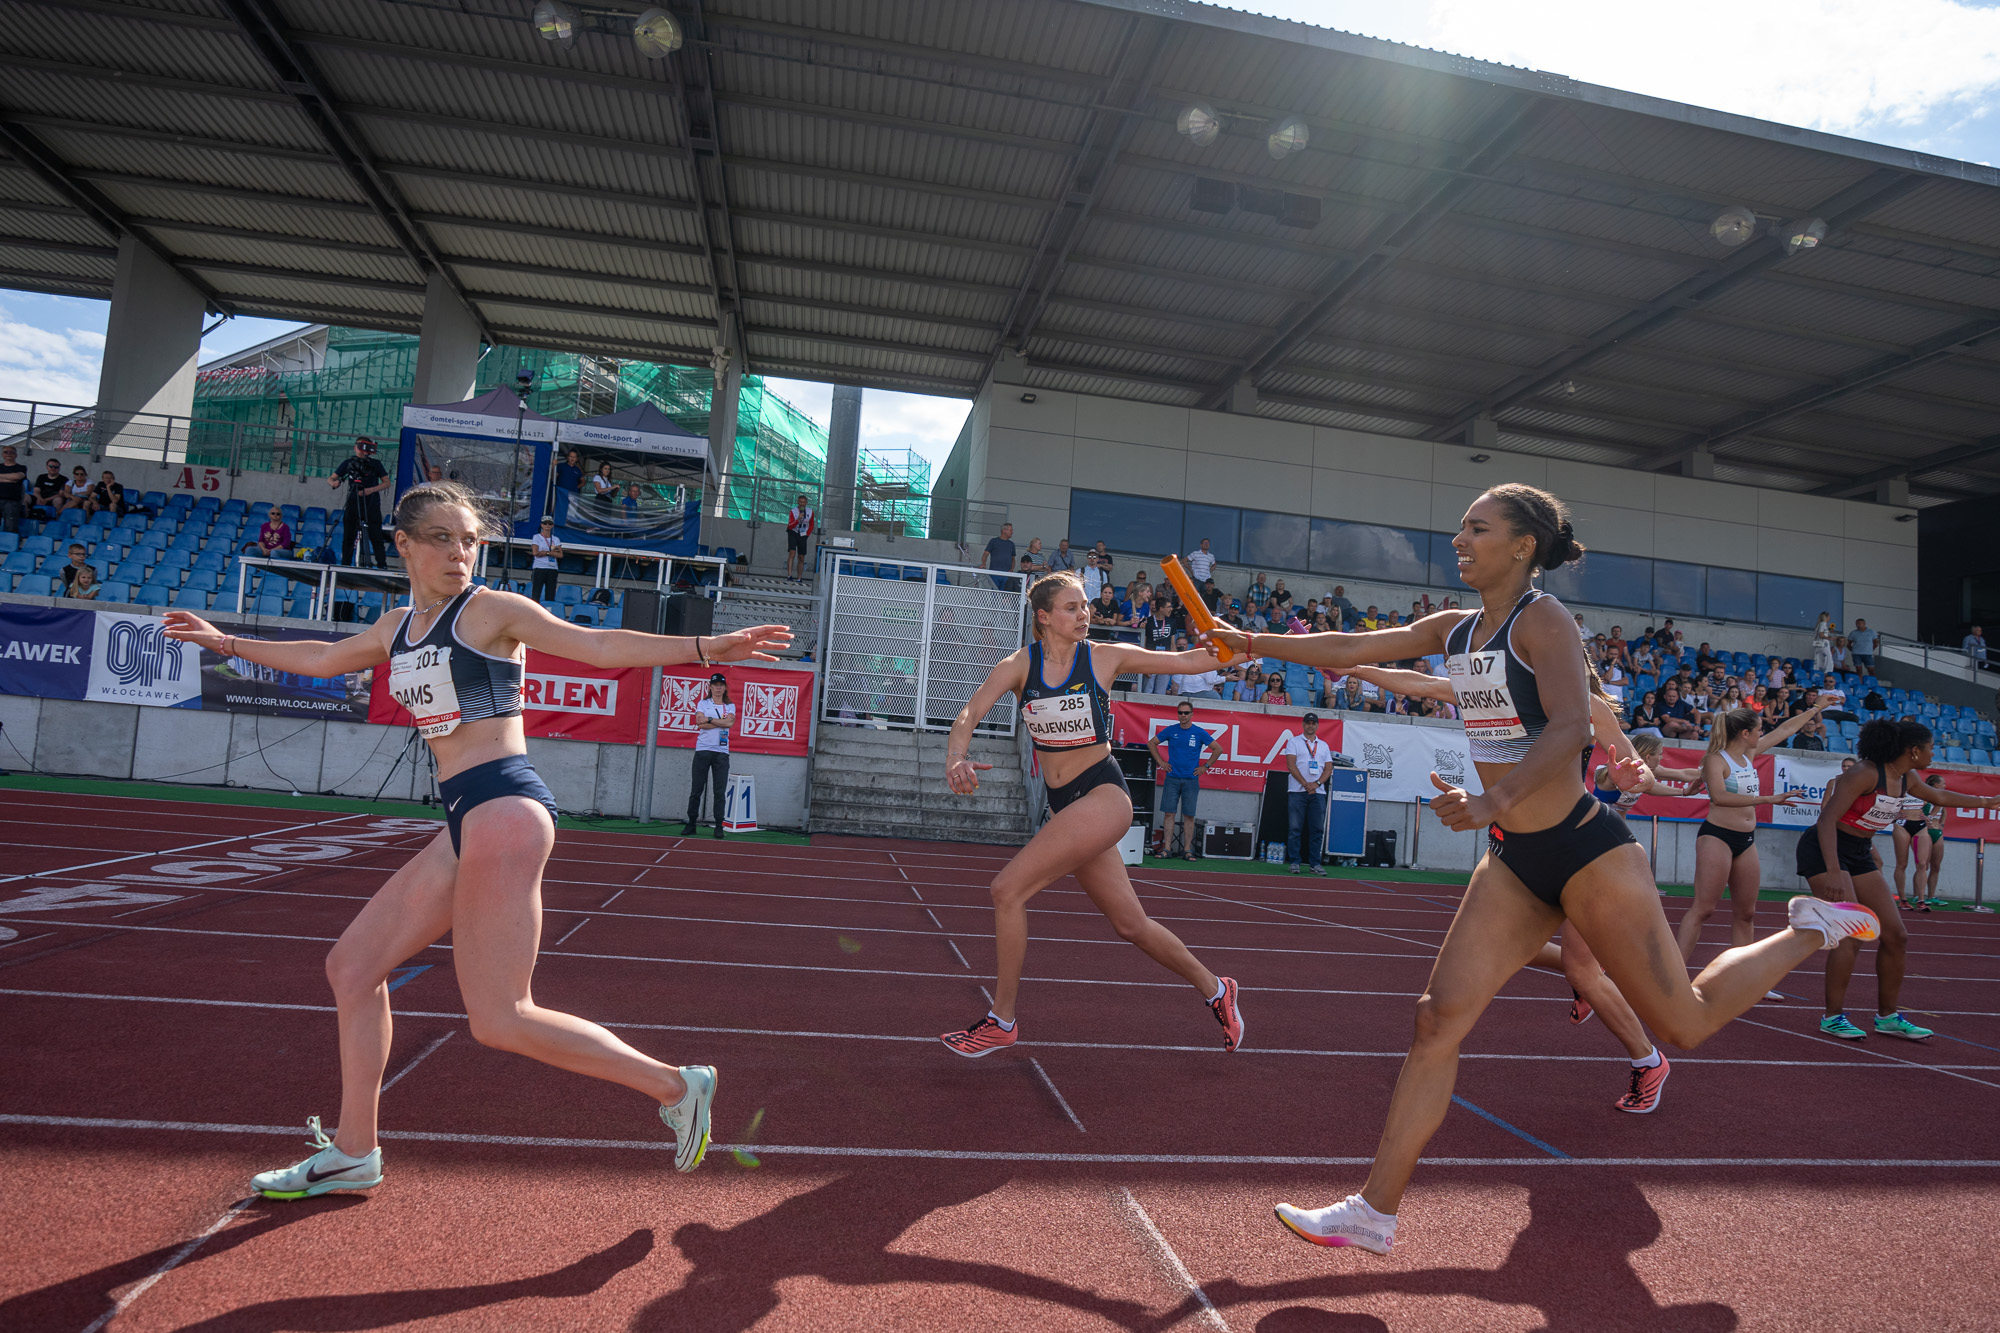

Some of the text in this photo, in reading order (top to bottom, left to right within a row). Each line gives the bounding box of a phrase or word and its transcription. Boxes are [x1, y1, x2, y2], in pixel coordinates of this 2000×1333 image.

[430, 415, 483, 427] domtel-sport.pl
[584, 431, 642, 444] domtel-sport.pl
[0, 641, 82, 664] AWEK
[416, 650, 439, 671] 101
[1470, 656, 1496, 675] 107
[102, 687, 179, 700] WŁOCŁAWEK
[226, 694, 353, 713] WWW.OSIR.WLOCLAWEK.PL
[1060, 697, 1085, 711] 285
[431, 724, 449, 734] 2023
[743, 719, 792, 738] PZLA
[1029, 718, 1091, 734] GAJEWSKA
[1229, 768, 1265, 778] LEKKIEJ
[1368, 769, 1393, 779] estlé
[1439, 774, 1464, 784] estlé
[1778, 768, 1786, 779] 4
[742, 786, 751, 819] 1
[1783, 806, 1812, 817] VIENNA
[1322, 1223, 1384, 1241] new balance
